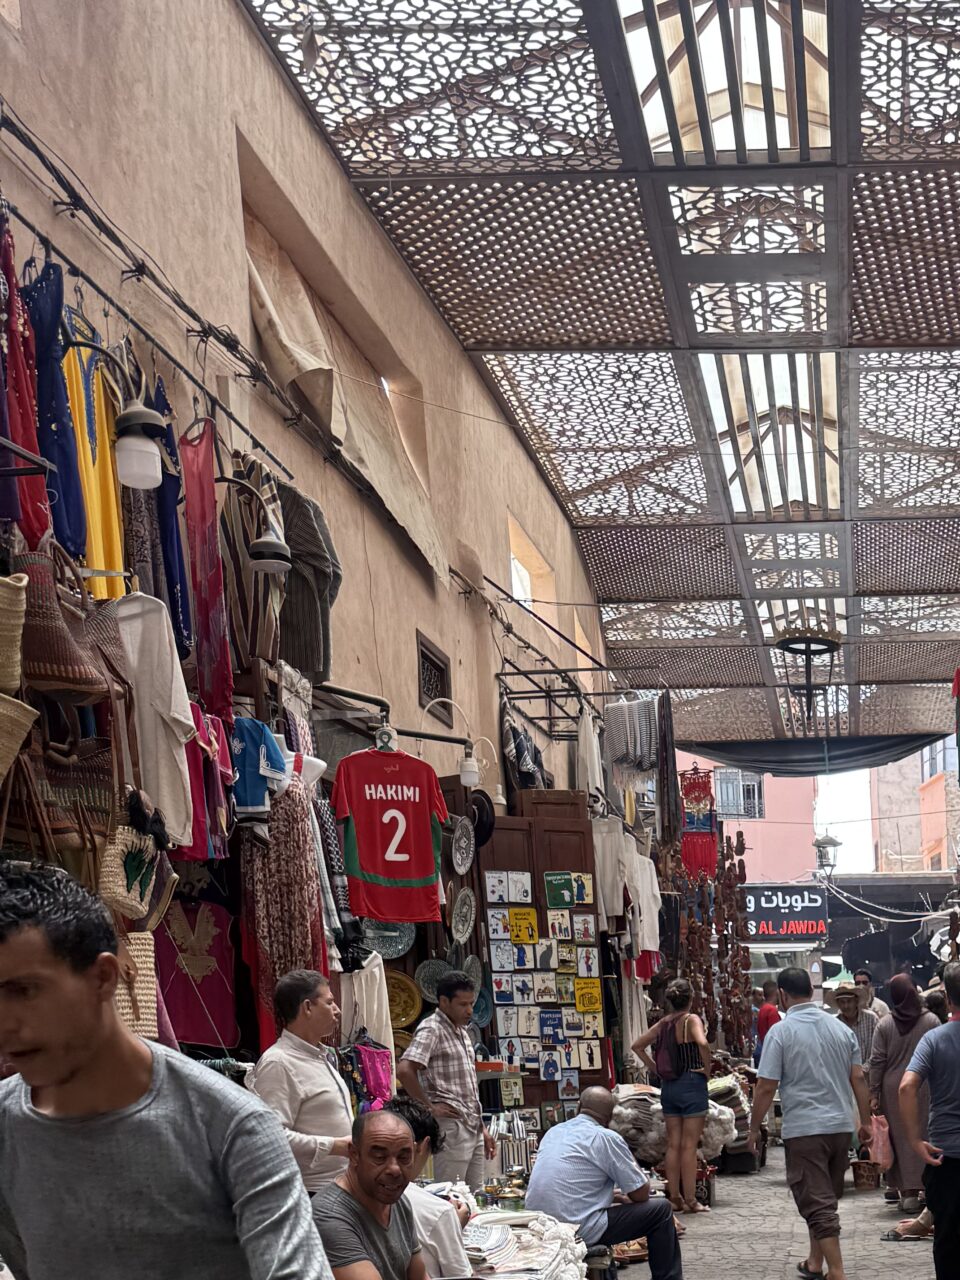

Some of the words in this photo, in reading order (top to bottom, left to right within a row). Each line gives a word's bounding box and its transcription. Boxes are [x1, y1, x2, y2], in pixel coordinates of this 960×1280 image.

[364, 784, 420, 803] HAKIMI
[381, 808, 410, 862] 2
[760, 891, 822, 913] حلويات
[758, 920, 777, 935] AL
[779, 920, 826, 935] JAWDA
